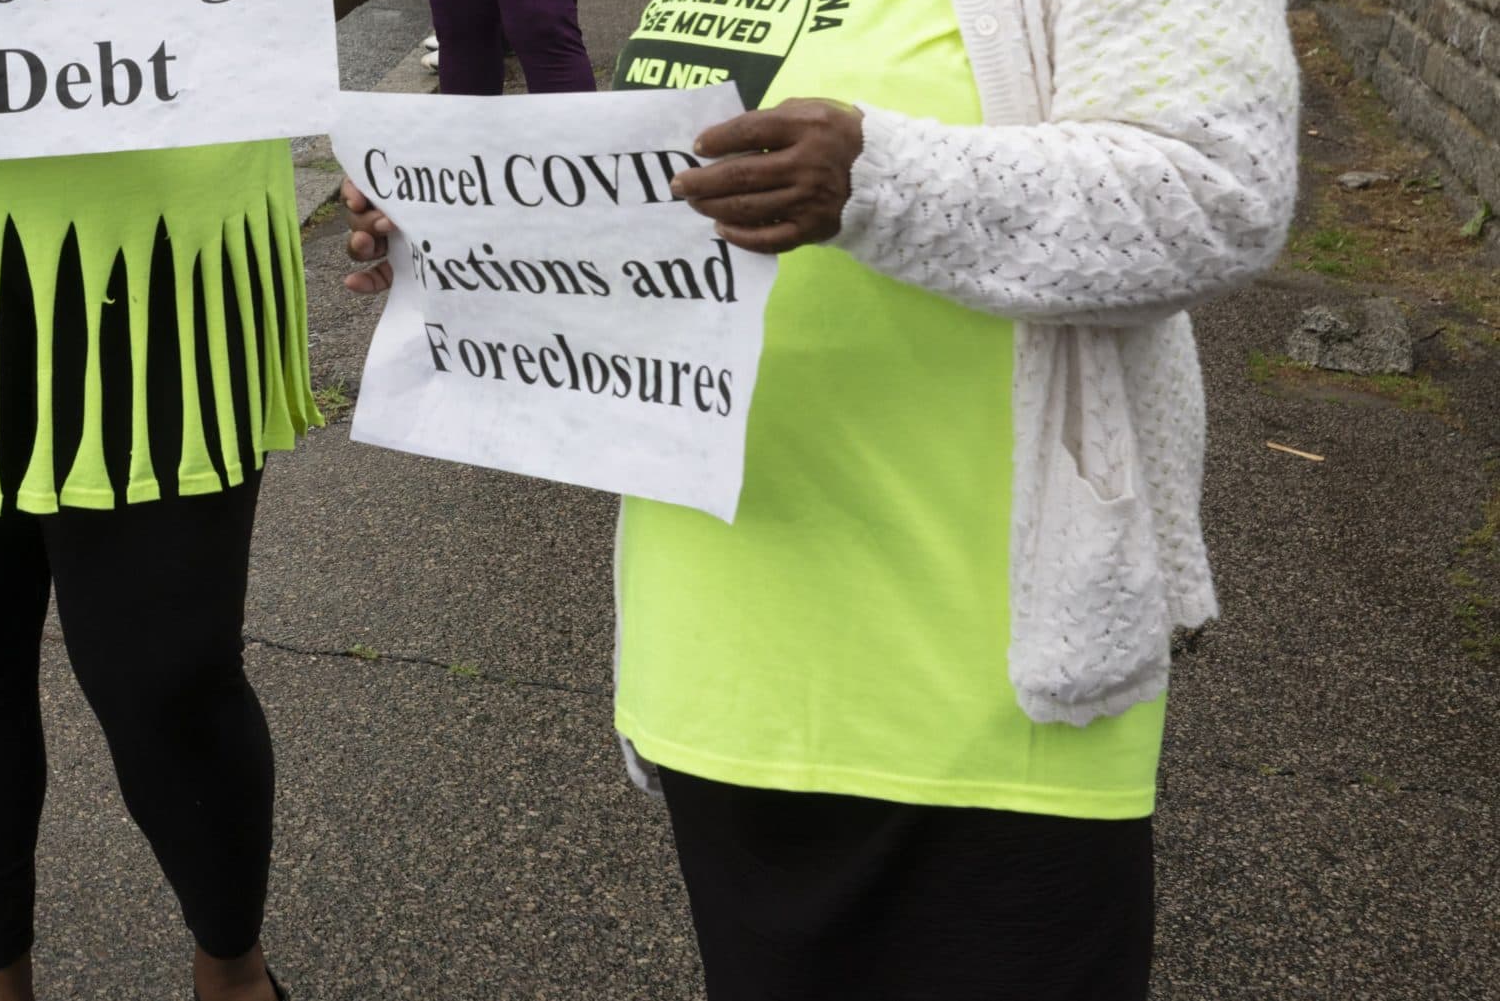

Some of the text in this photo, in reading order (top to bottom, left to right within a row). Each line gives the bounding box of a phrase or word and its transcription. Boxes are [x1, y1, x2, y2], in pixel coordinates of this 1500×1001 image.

[671, 11, 772, 44] MOVED
[625, 57, 668, 86] NO
[364, 148, 497, 207] Cancel
[622, 237, 739, 303] and
[424, 322, 734, 417] Foreclosures
